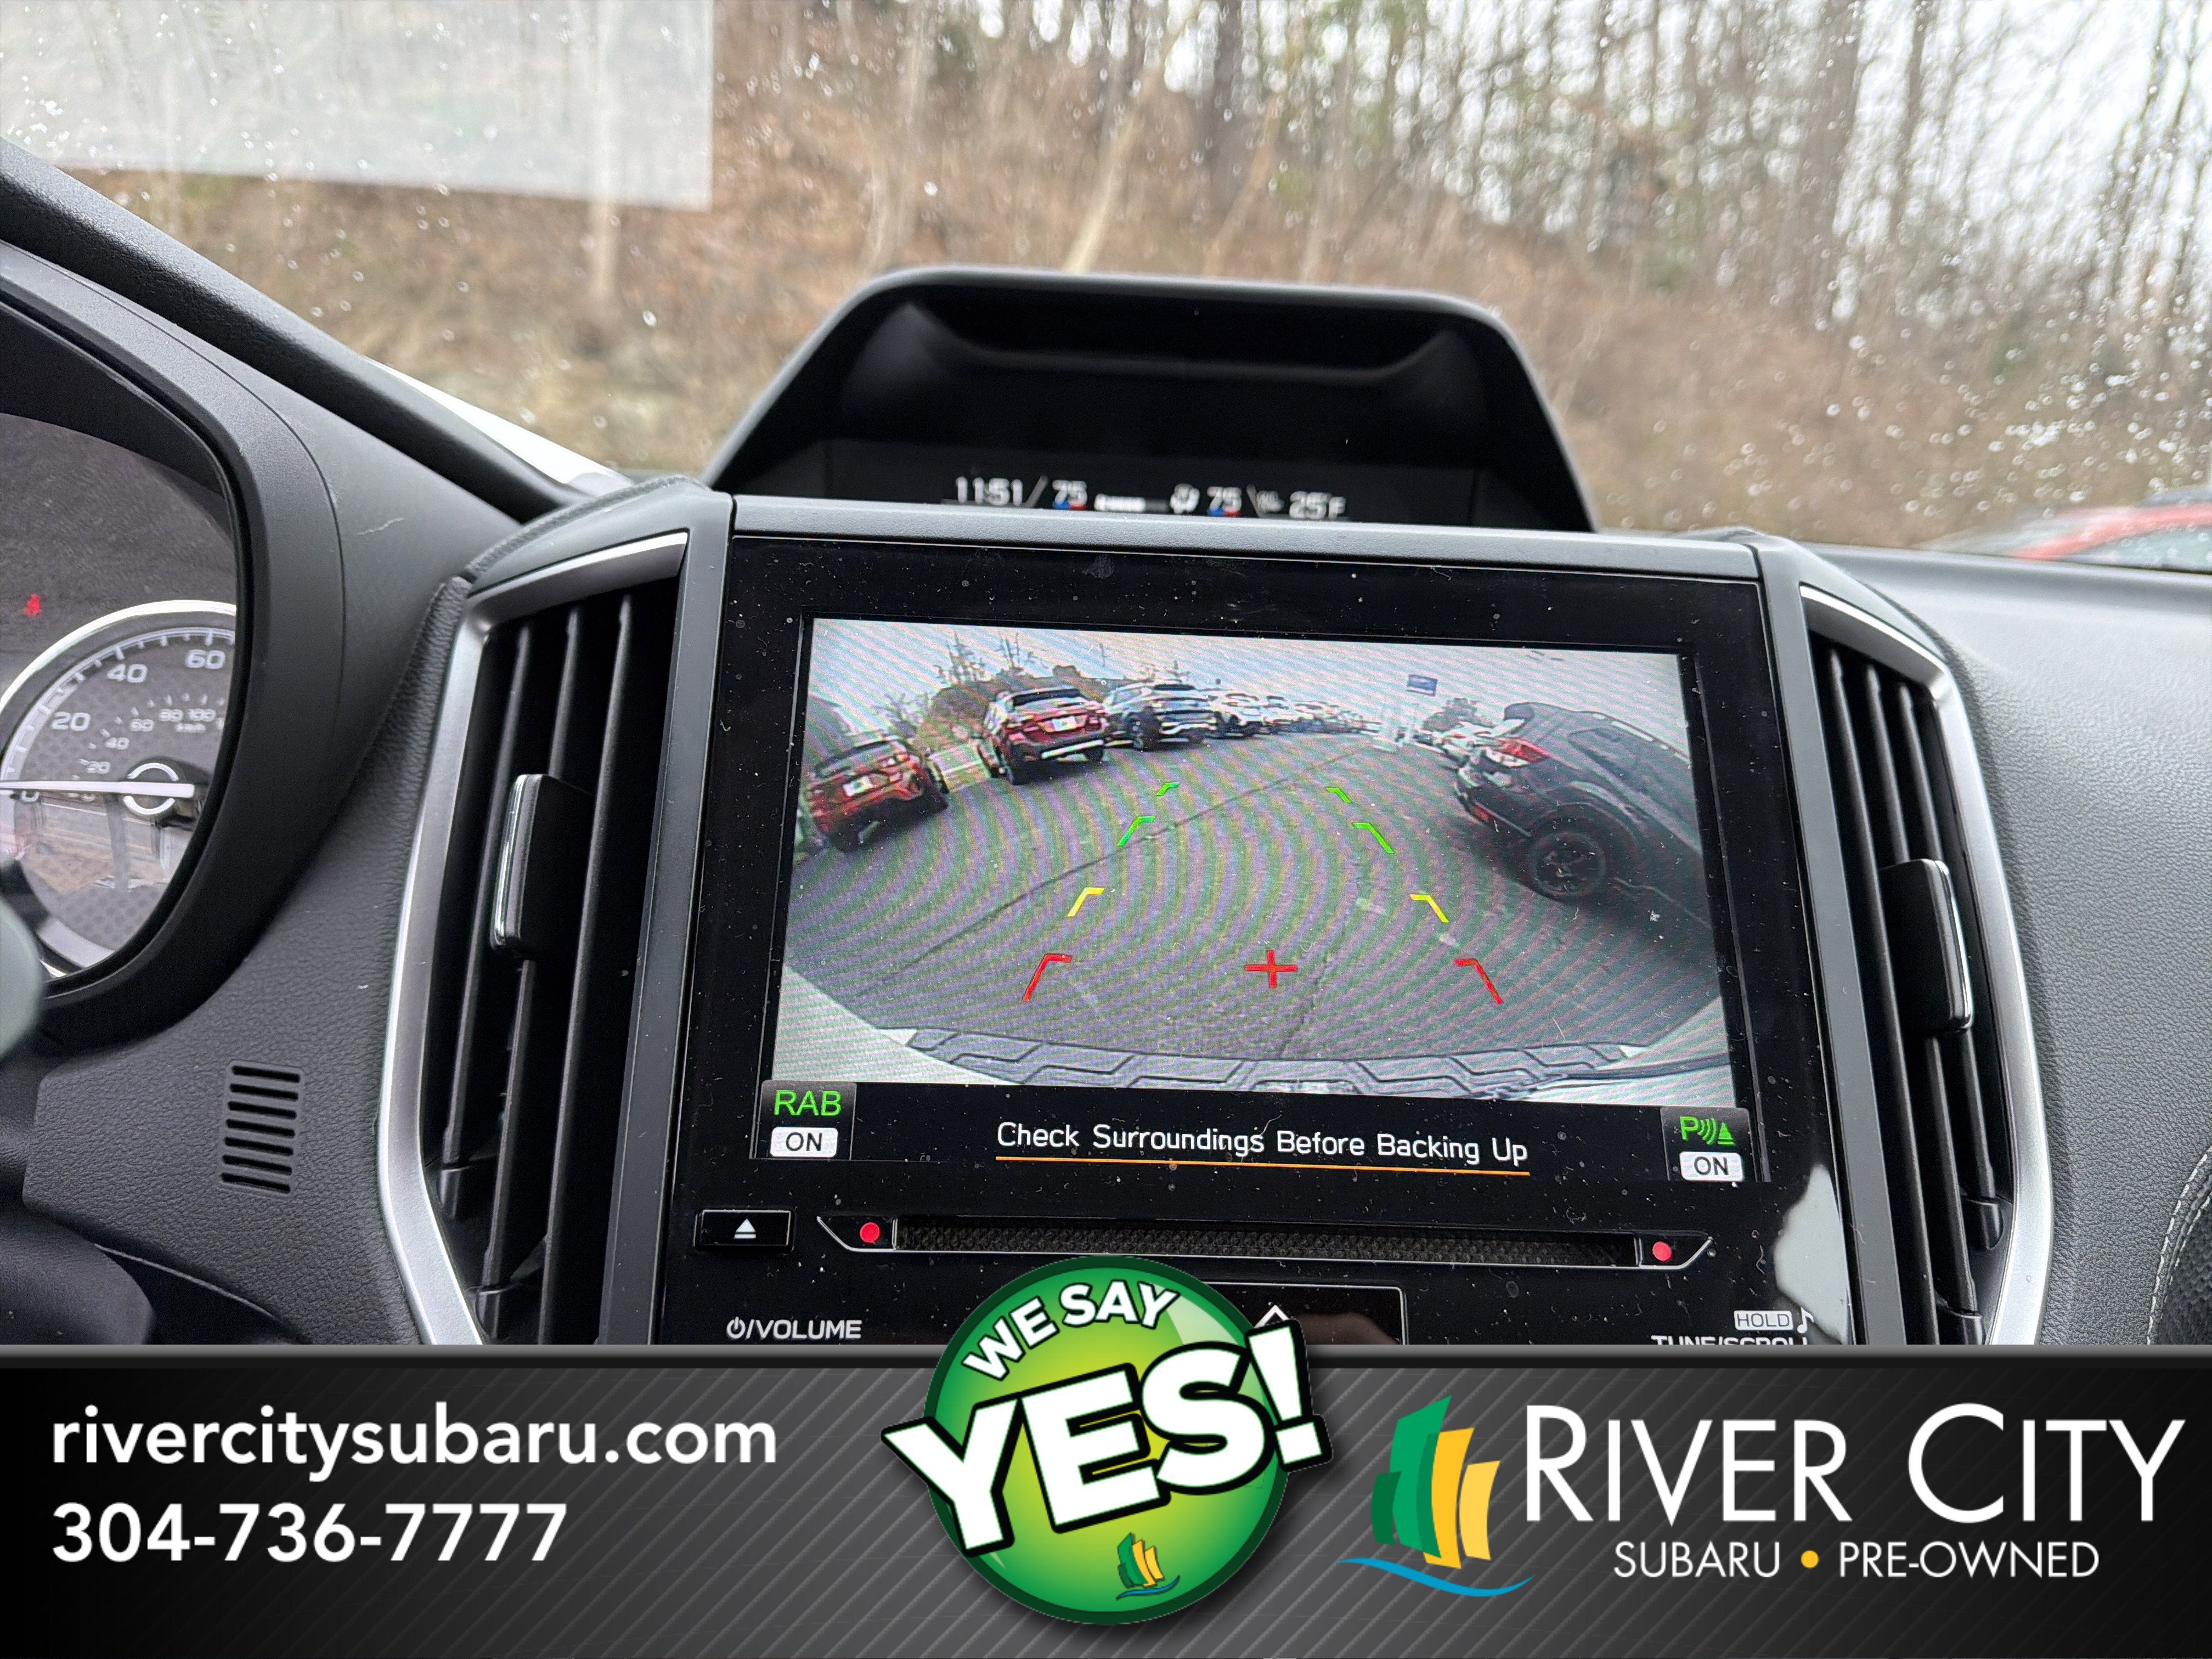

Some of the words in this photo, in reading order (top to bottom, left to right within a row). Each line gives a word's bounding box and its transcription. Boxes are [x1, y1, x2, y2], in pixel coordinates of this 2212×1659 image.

[185, 649, 226, 669] 60
[107, 663, 148, 683] 40
[50, 712, 91, 731] 20
[774, 1090, 842, 1116] RAB
[786, 1132, 822, 1152] ON
[997, 1122, 1080, 1147] Check
[1093, 1124, 1265, 1157] Surroundings
[1277, 1130, 1365, 1155] Before
[1377, 1133, 1480, 1165] Backing
[1492, 1137, 1528, 1167] Up
[1694, 1156, 1729, 1176] ON
[1737, 1313, 1790, 1328] HOLD
